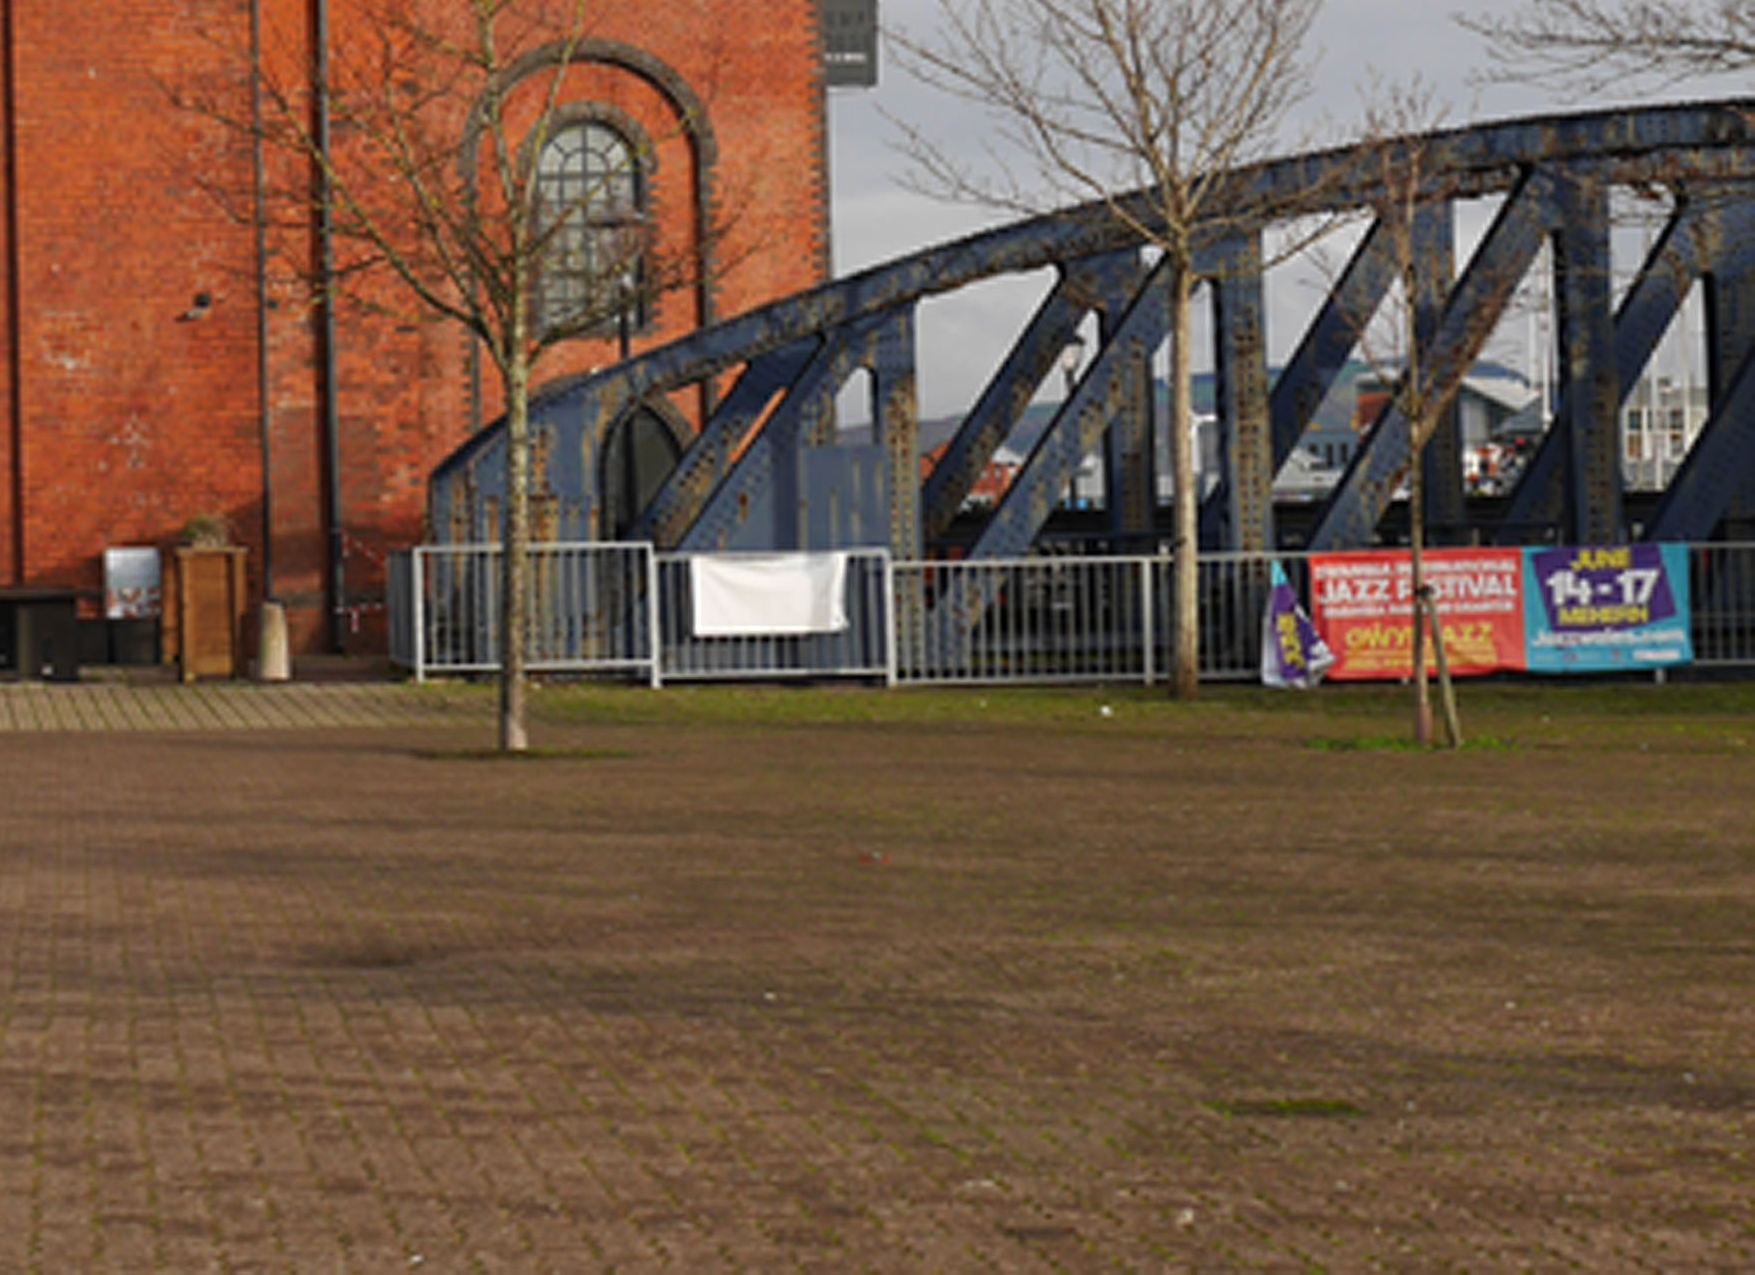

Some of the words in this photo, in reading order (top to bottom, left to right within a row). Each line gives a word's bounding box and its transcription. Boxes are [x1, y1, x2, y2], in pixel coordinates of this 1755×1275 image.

[1570, 547, 1631, 571] JUNE
[1319, 578, 1390, 605] JAZZ
[1397, 574, 1517, 601] FSTIVAL
[1546, 570, 1592, 606] 14
[1616, 569, 1661, 605] 17
